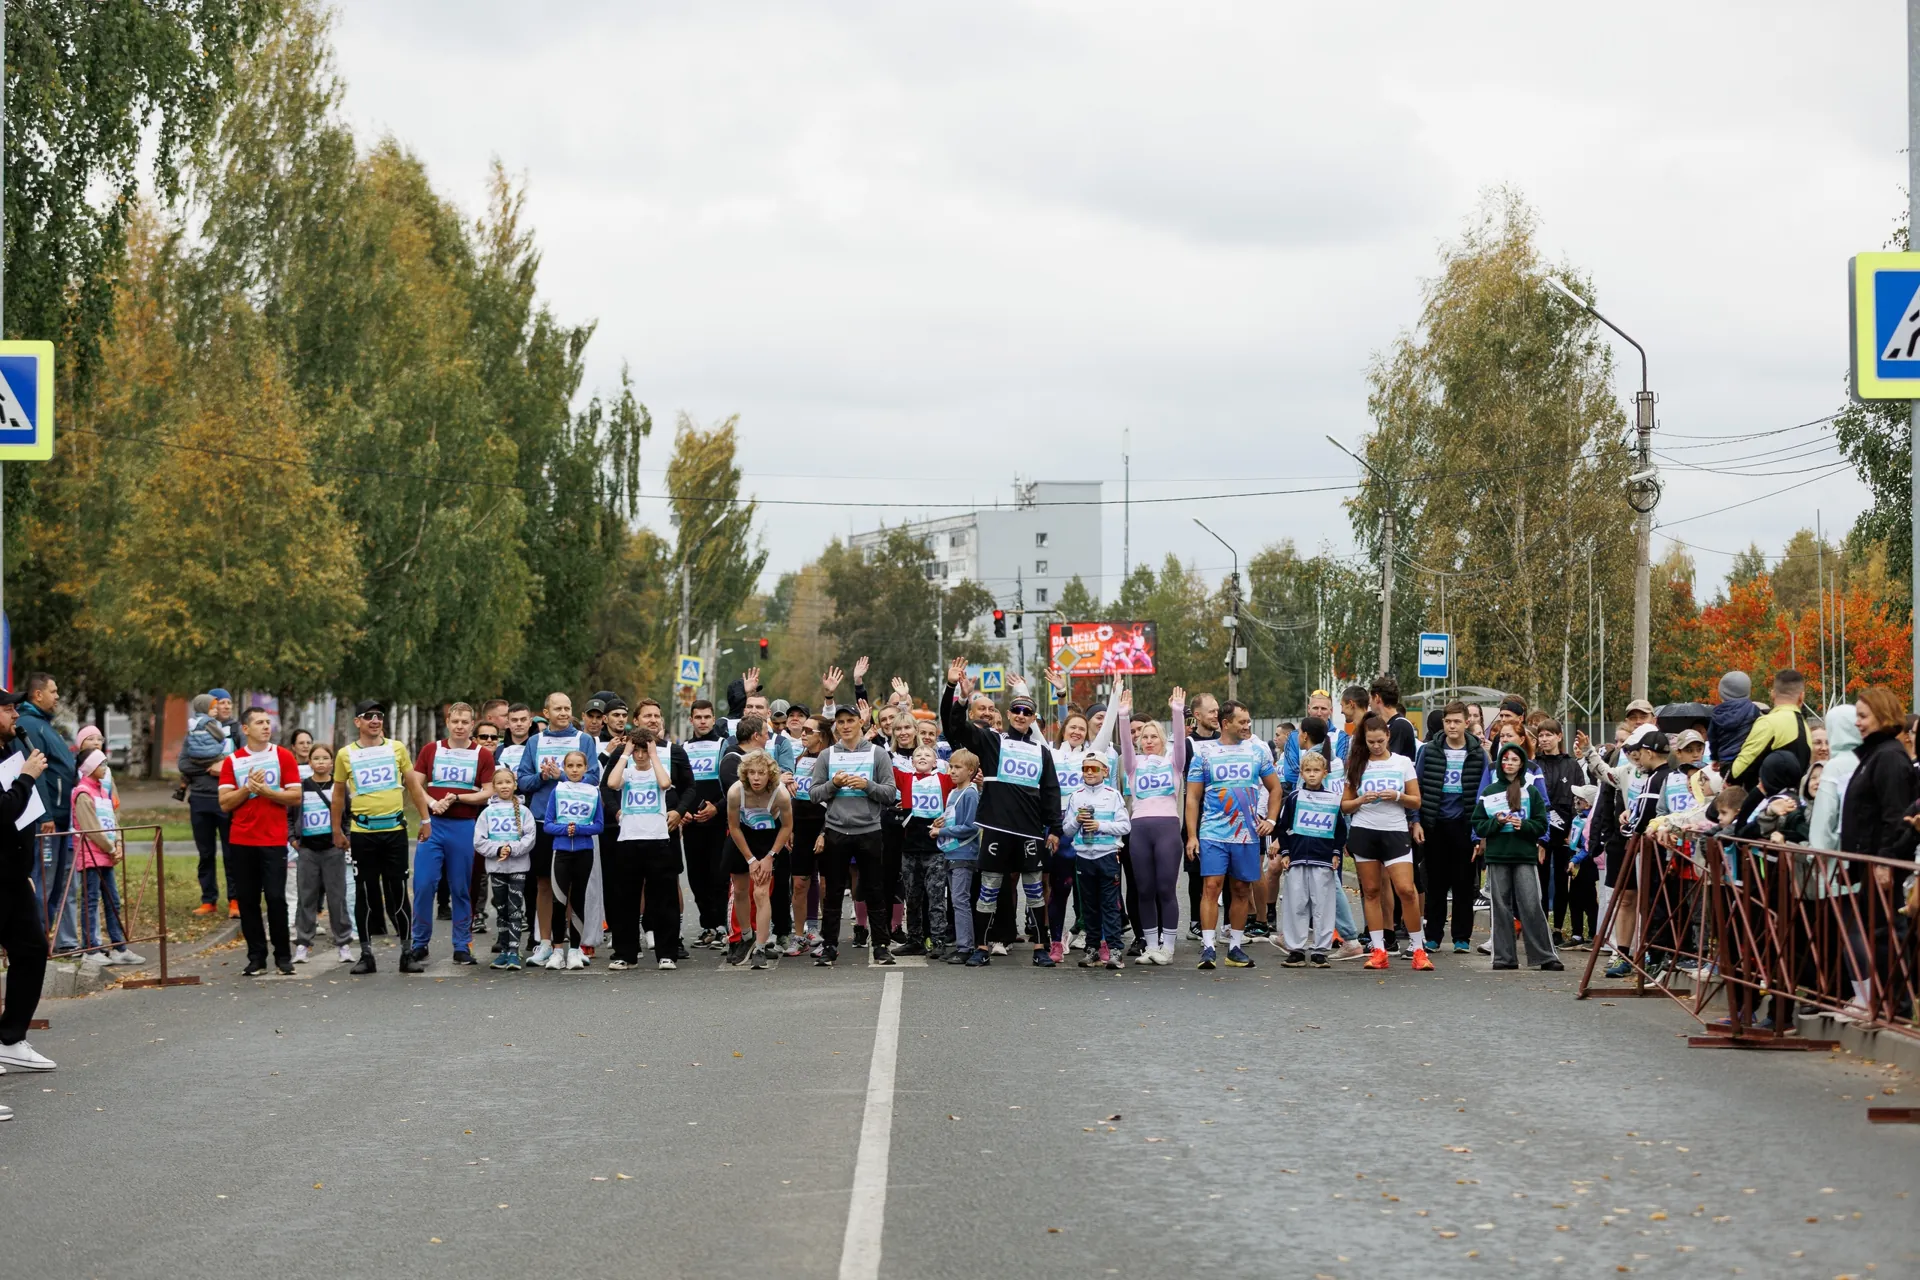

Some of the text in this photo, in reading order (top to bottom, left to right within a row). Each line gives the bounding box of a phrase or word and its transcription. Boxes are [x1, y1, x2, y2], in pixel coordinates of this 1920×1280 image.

[690, 758, 713, 772] 42
[1003, 758, 1038, 778] 050
[1215, 763, 1251, 780] 056
[360, 766, 393, 785] 252
[441, 766, 467, 782] 181
[1138, 773, 1171, 790] 052
[1363, 779, 1398, 793] 055
[627, 790, 657, 806] 009
[911, 794, 940, 810] 020
[560, 800, 591, 817] 262
[303, 811, 329, 828] 107
[1299, 811, 1333, 830] 444
